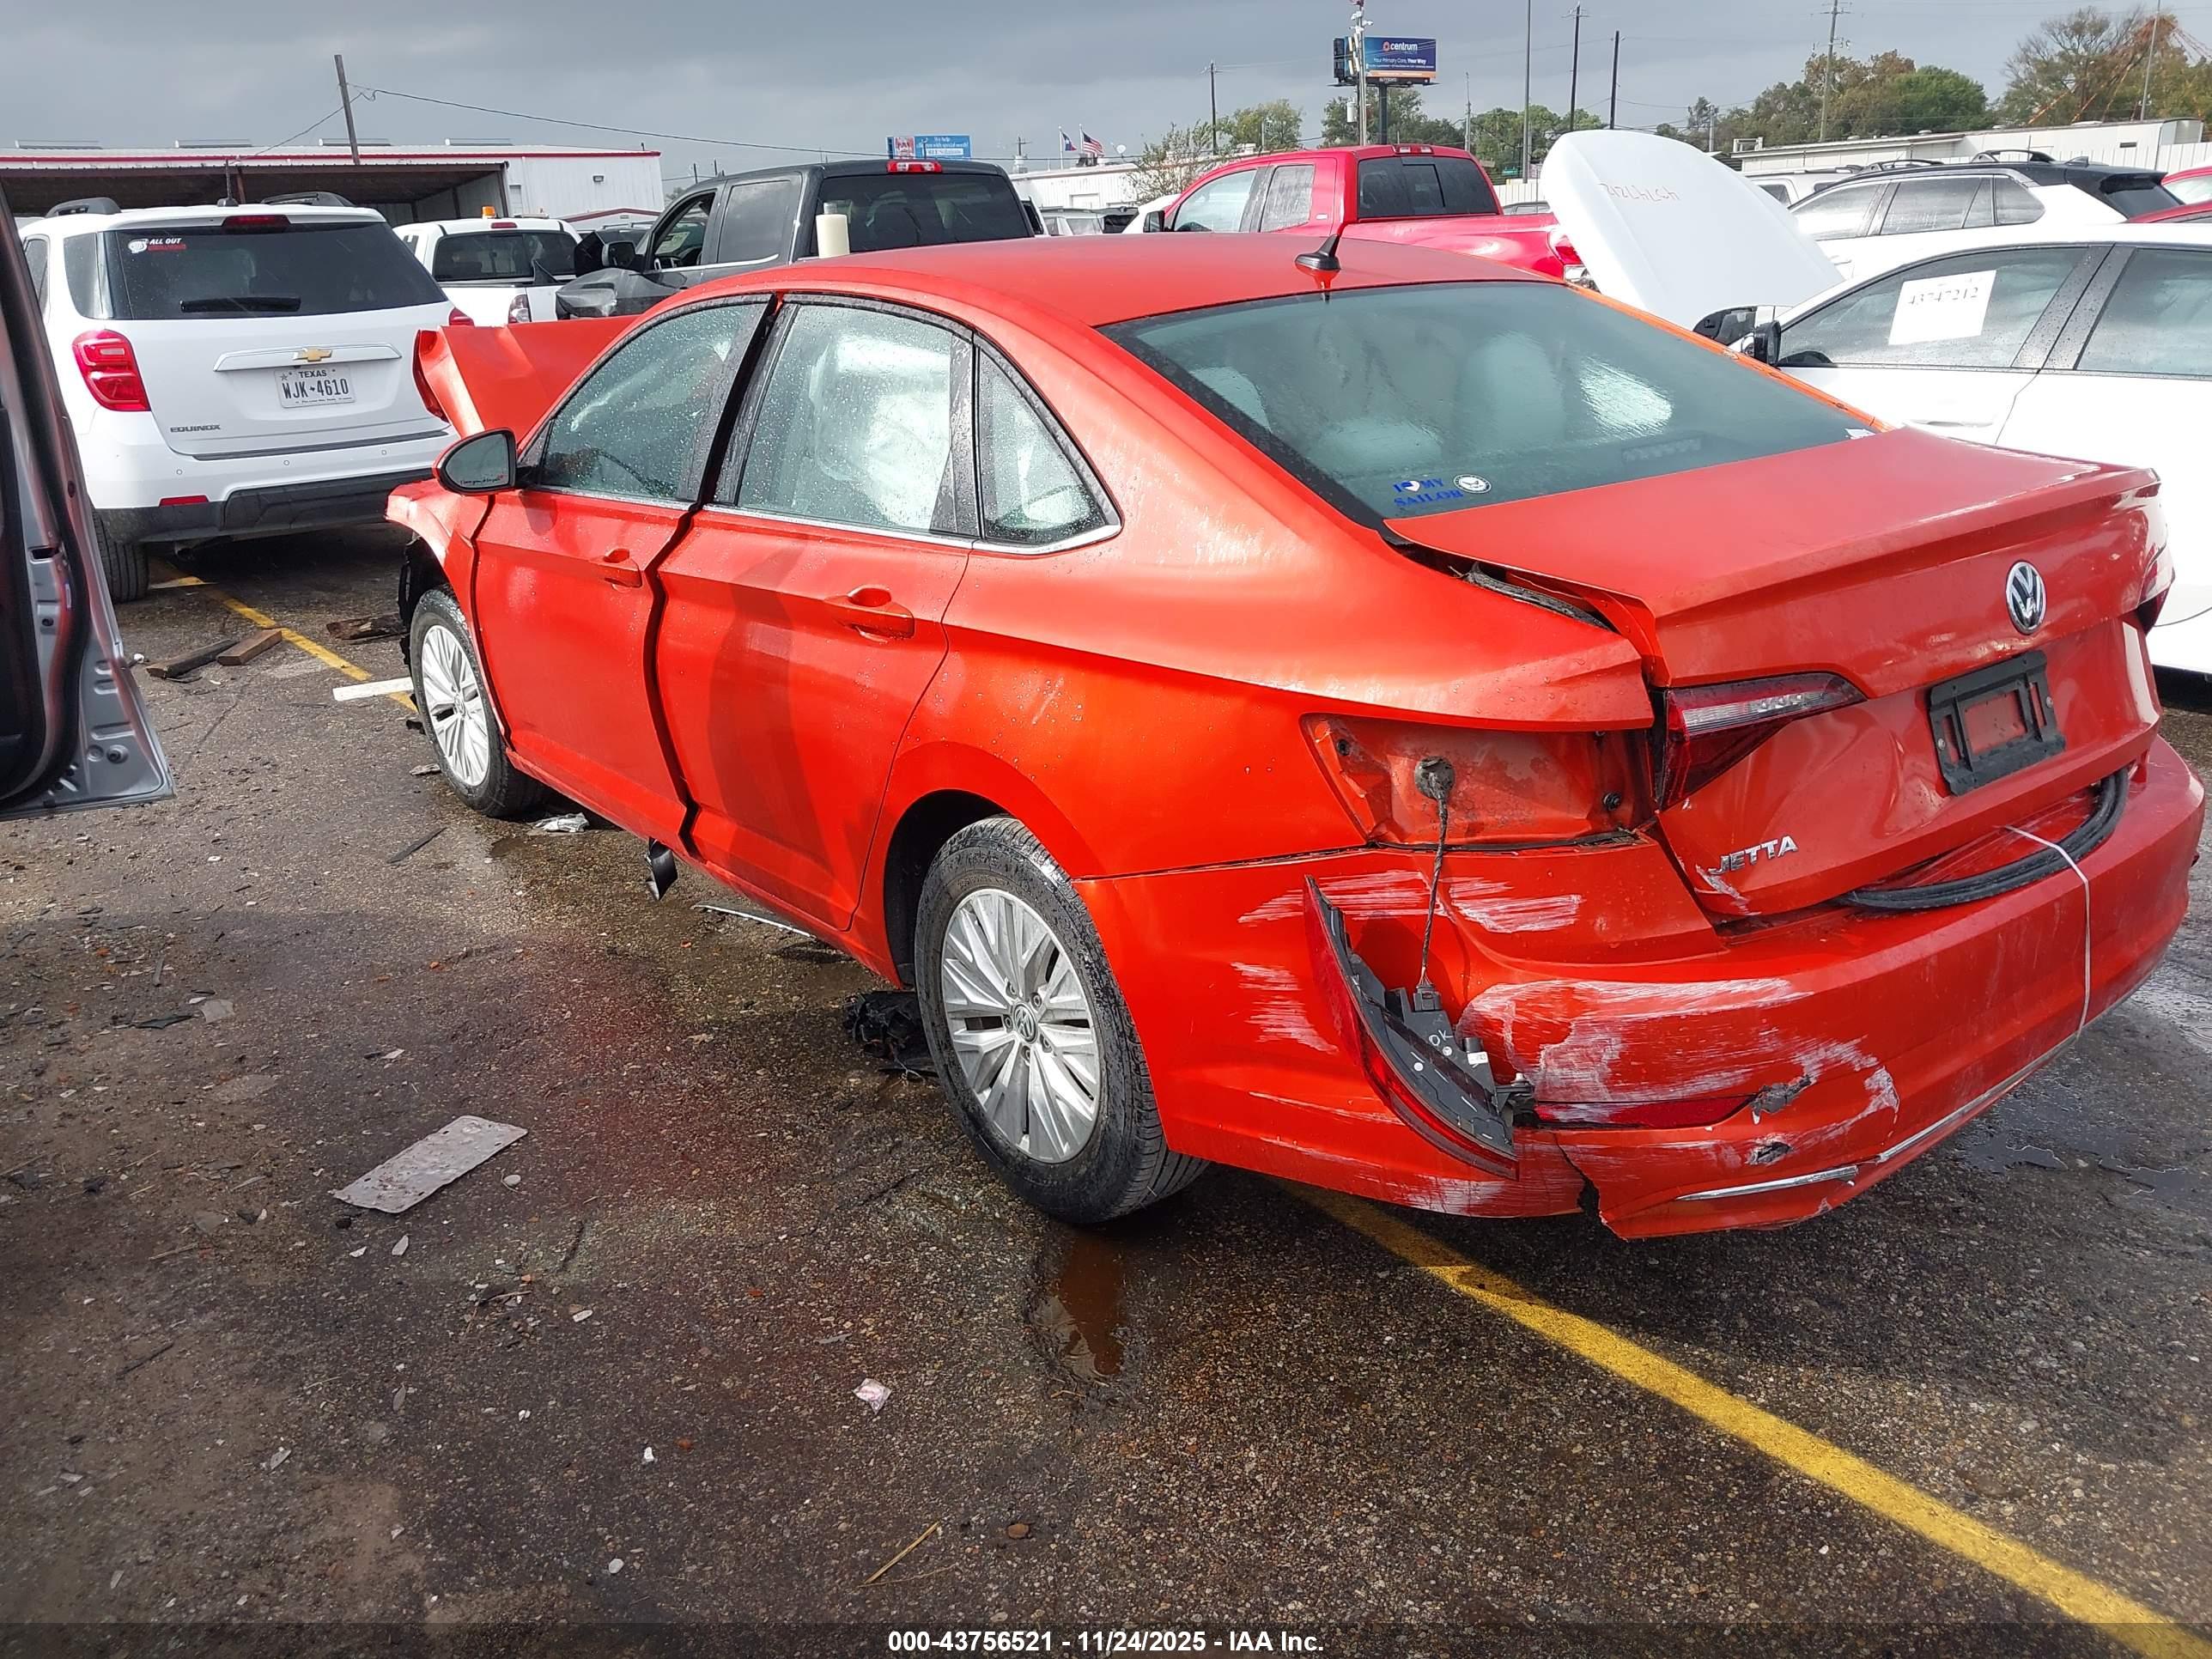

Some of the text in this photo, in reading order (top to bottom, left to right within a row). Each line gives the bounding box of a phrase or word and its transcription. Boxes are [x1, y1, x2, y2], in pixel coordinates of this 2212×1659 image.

[1391, 42, 1418, 51] centrum
[298, 369, 327, 379] TEXAS
[170, 424, 221, 433] EQUINOX
[1420, 478, 1443, 489] MY
[1394, 489, 1463, 507] SAILOR
[1707, 836, 1798, 874] JETTA
[1428, 1030, 1454, 1046] OK
